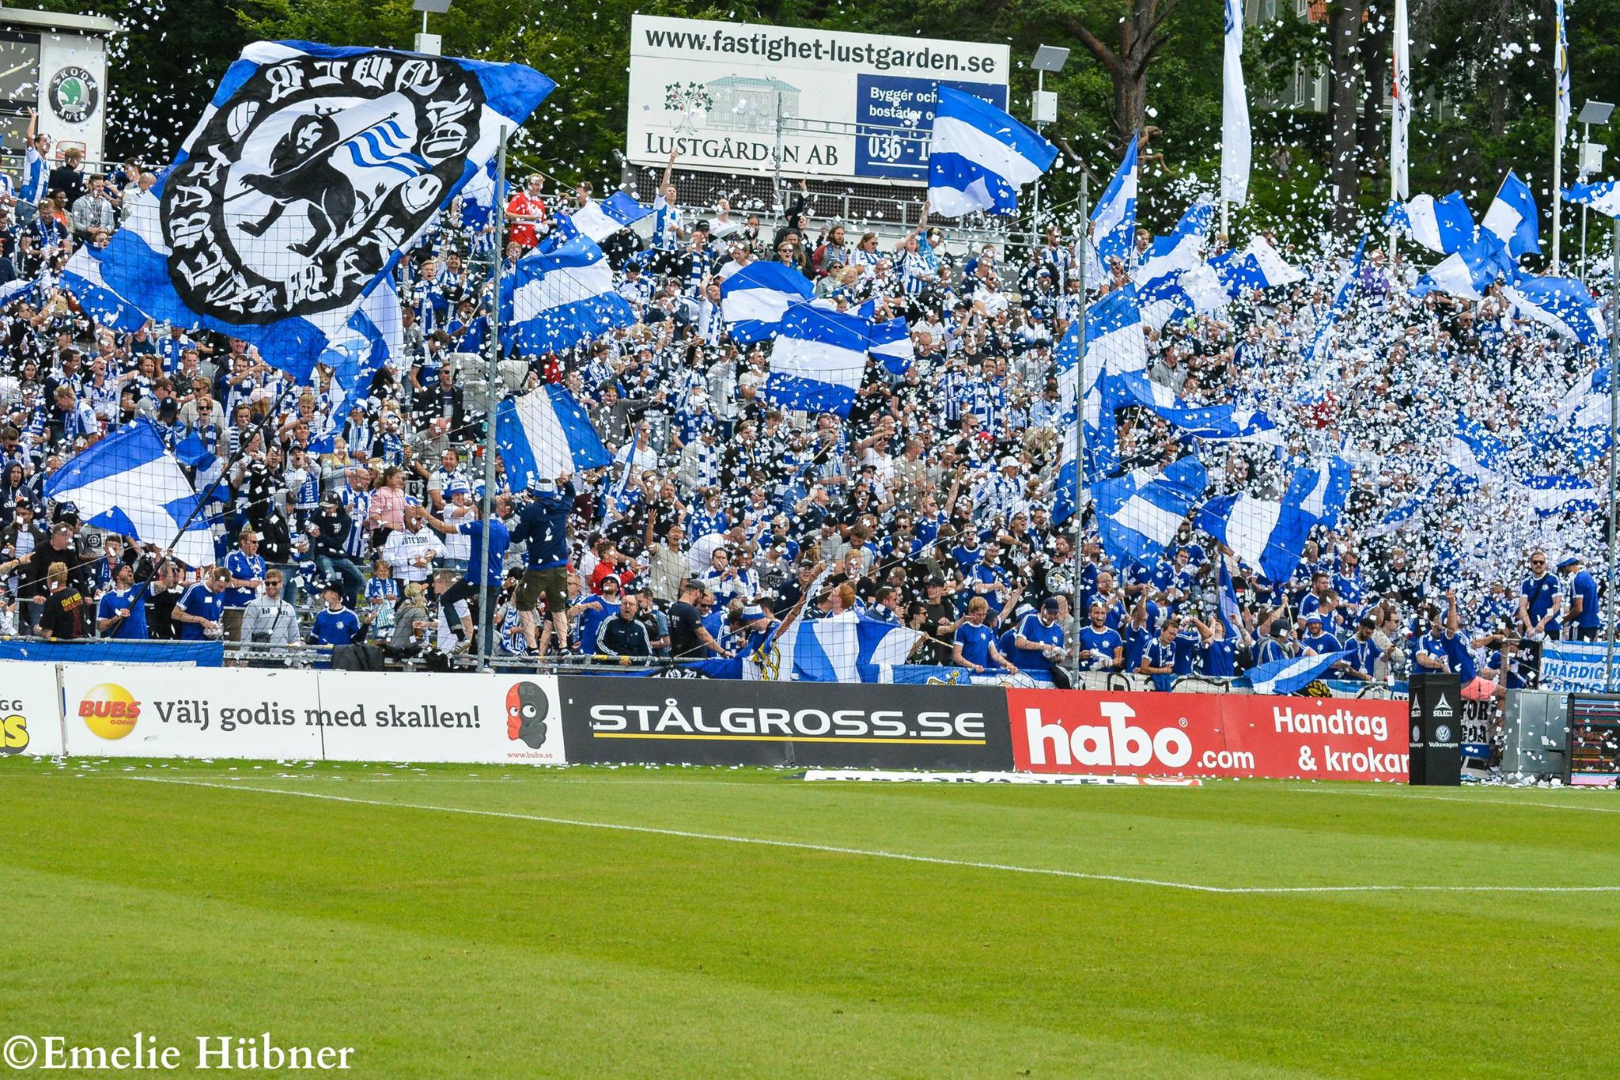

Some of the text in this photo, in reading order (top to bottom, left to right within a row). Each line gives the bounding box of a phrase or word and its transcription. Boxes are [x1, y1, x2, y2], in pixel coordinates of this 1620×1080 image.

[645, 29, 996, 73] www.fastighet-lustgarden.se
[805, 144, 839, 166] AB
[868, 133, 902, 159] 036
[78, 700, 142, 718] BUBS
[153, 699, 482, 732] Välj godis med skallen!
[588, 697, 987, 738] STÅLGROSS.SE
[1024, 700, 1193, 768] habo
[1272, 706, 1388, 742] Handtag
[506, 751, 553, 759] www.bubs.se
[1297, 745, 1318, 771] &
[1428, 741, 1459, 749] Volkswagen
